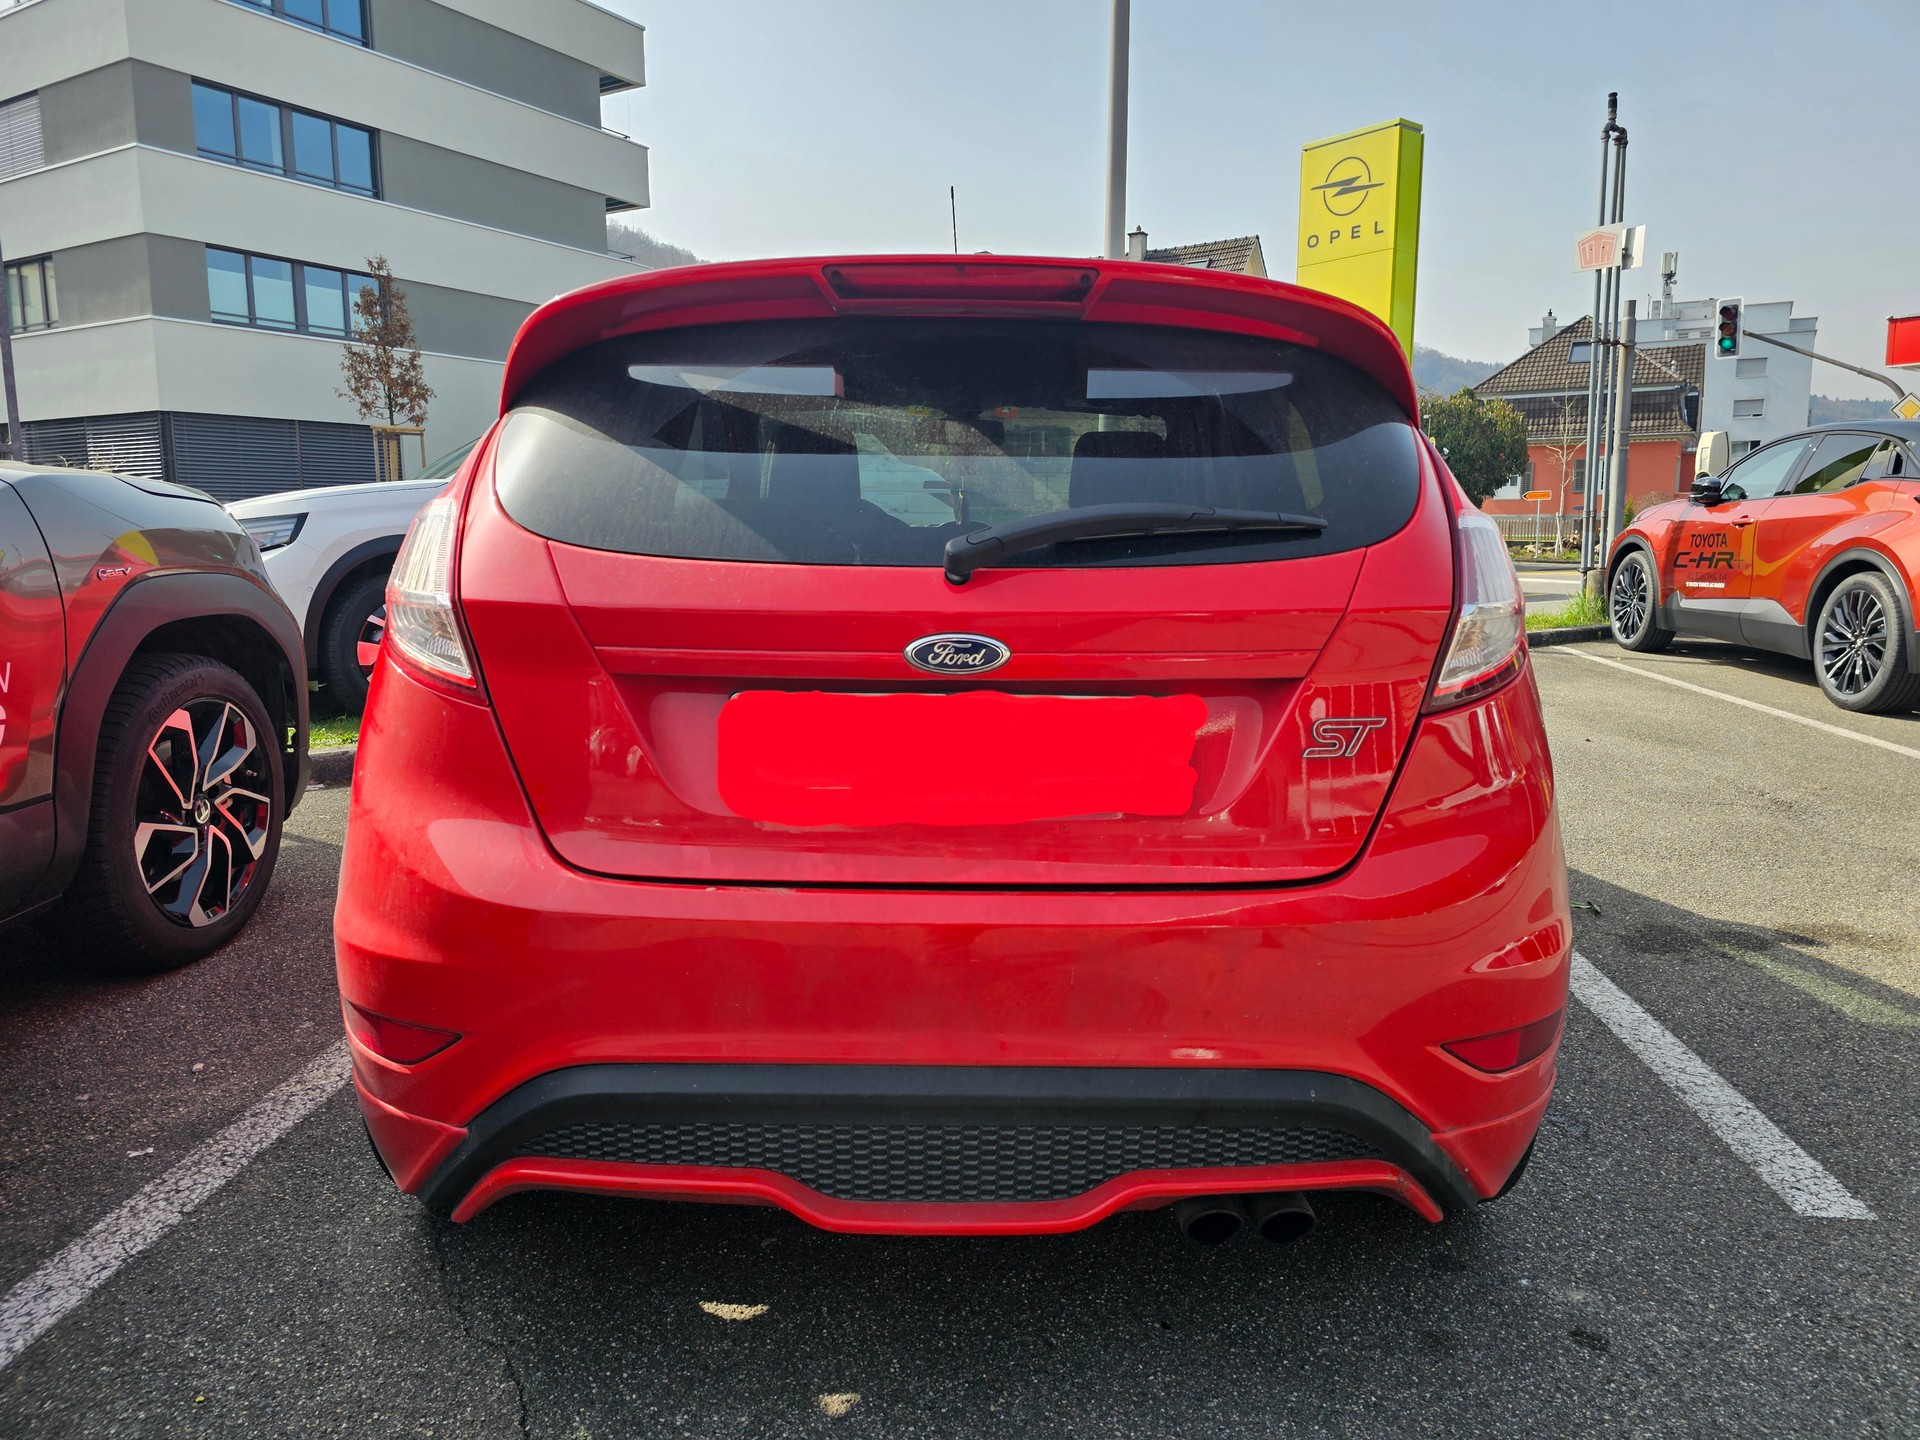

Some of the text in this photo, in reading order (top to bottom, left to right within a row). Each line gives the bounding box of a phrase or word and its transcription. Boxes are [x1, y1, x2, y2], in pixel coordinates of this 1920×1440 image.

[1307, 221, 1384, 248] OPEL
[1690, 533, 1728, 548] TOYOTA
[927, 641, 986, 666] Ford
[148, 674, 199, 725] Continental
[1302, 717, 1388, 758] ST
